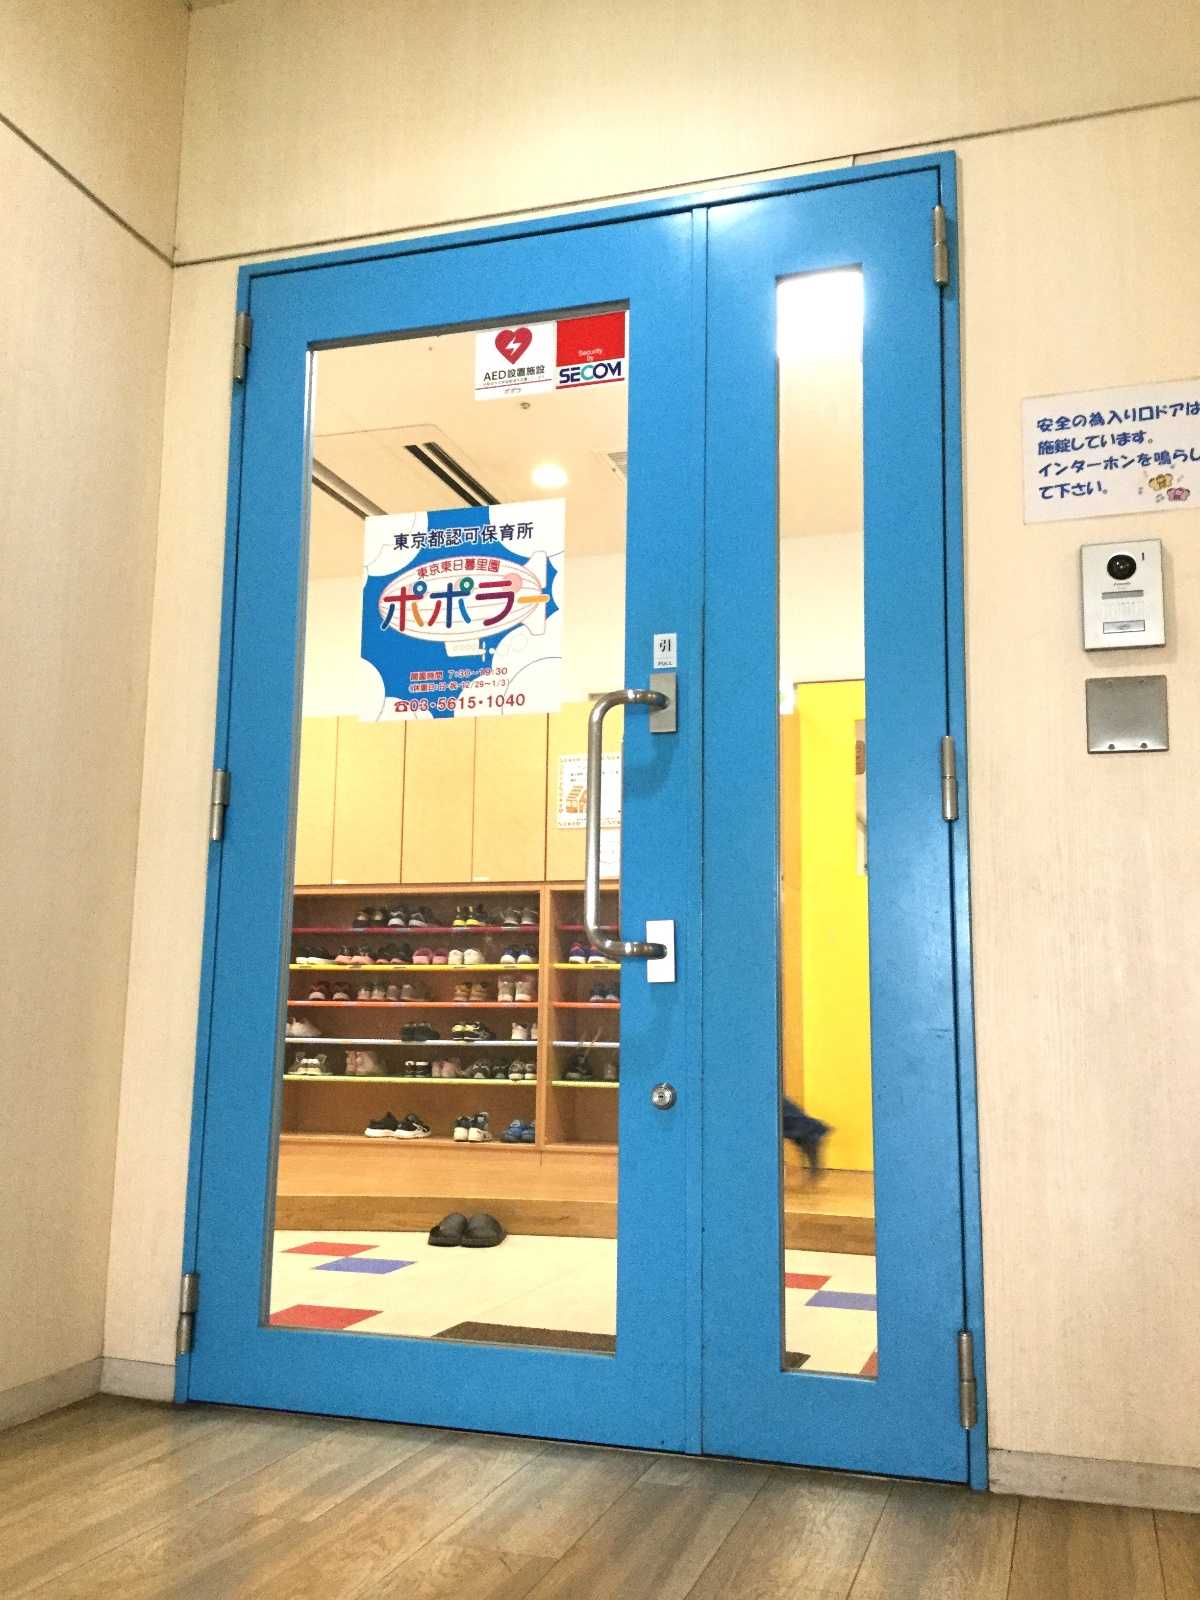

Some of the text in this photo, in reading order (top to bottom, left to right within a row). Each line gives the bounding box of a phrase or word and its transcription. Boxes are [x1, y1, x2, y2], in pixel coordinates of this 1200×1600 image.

[484, 365, 545, 382] AED設置施設
[559, 361, 622, 384] SECOM
[1037, 401, 1200, 432] 安全の為入り口ドアは
[1038, 430, 1153, 456] 施錠しています。
[1038, 448, 1200, 477] インターホンを鳴らし
[1038, 481, 1108, 500] て下さい。
[393, 522, 534, 550] 東京都認可保育所
[381, 577, 550, 631] ポポラー
[659, 639, 671, 653] 引
